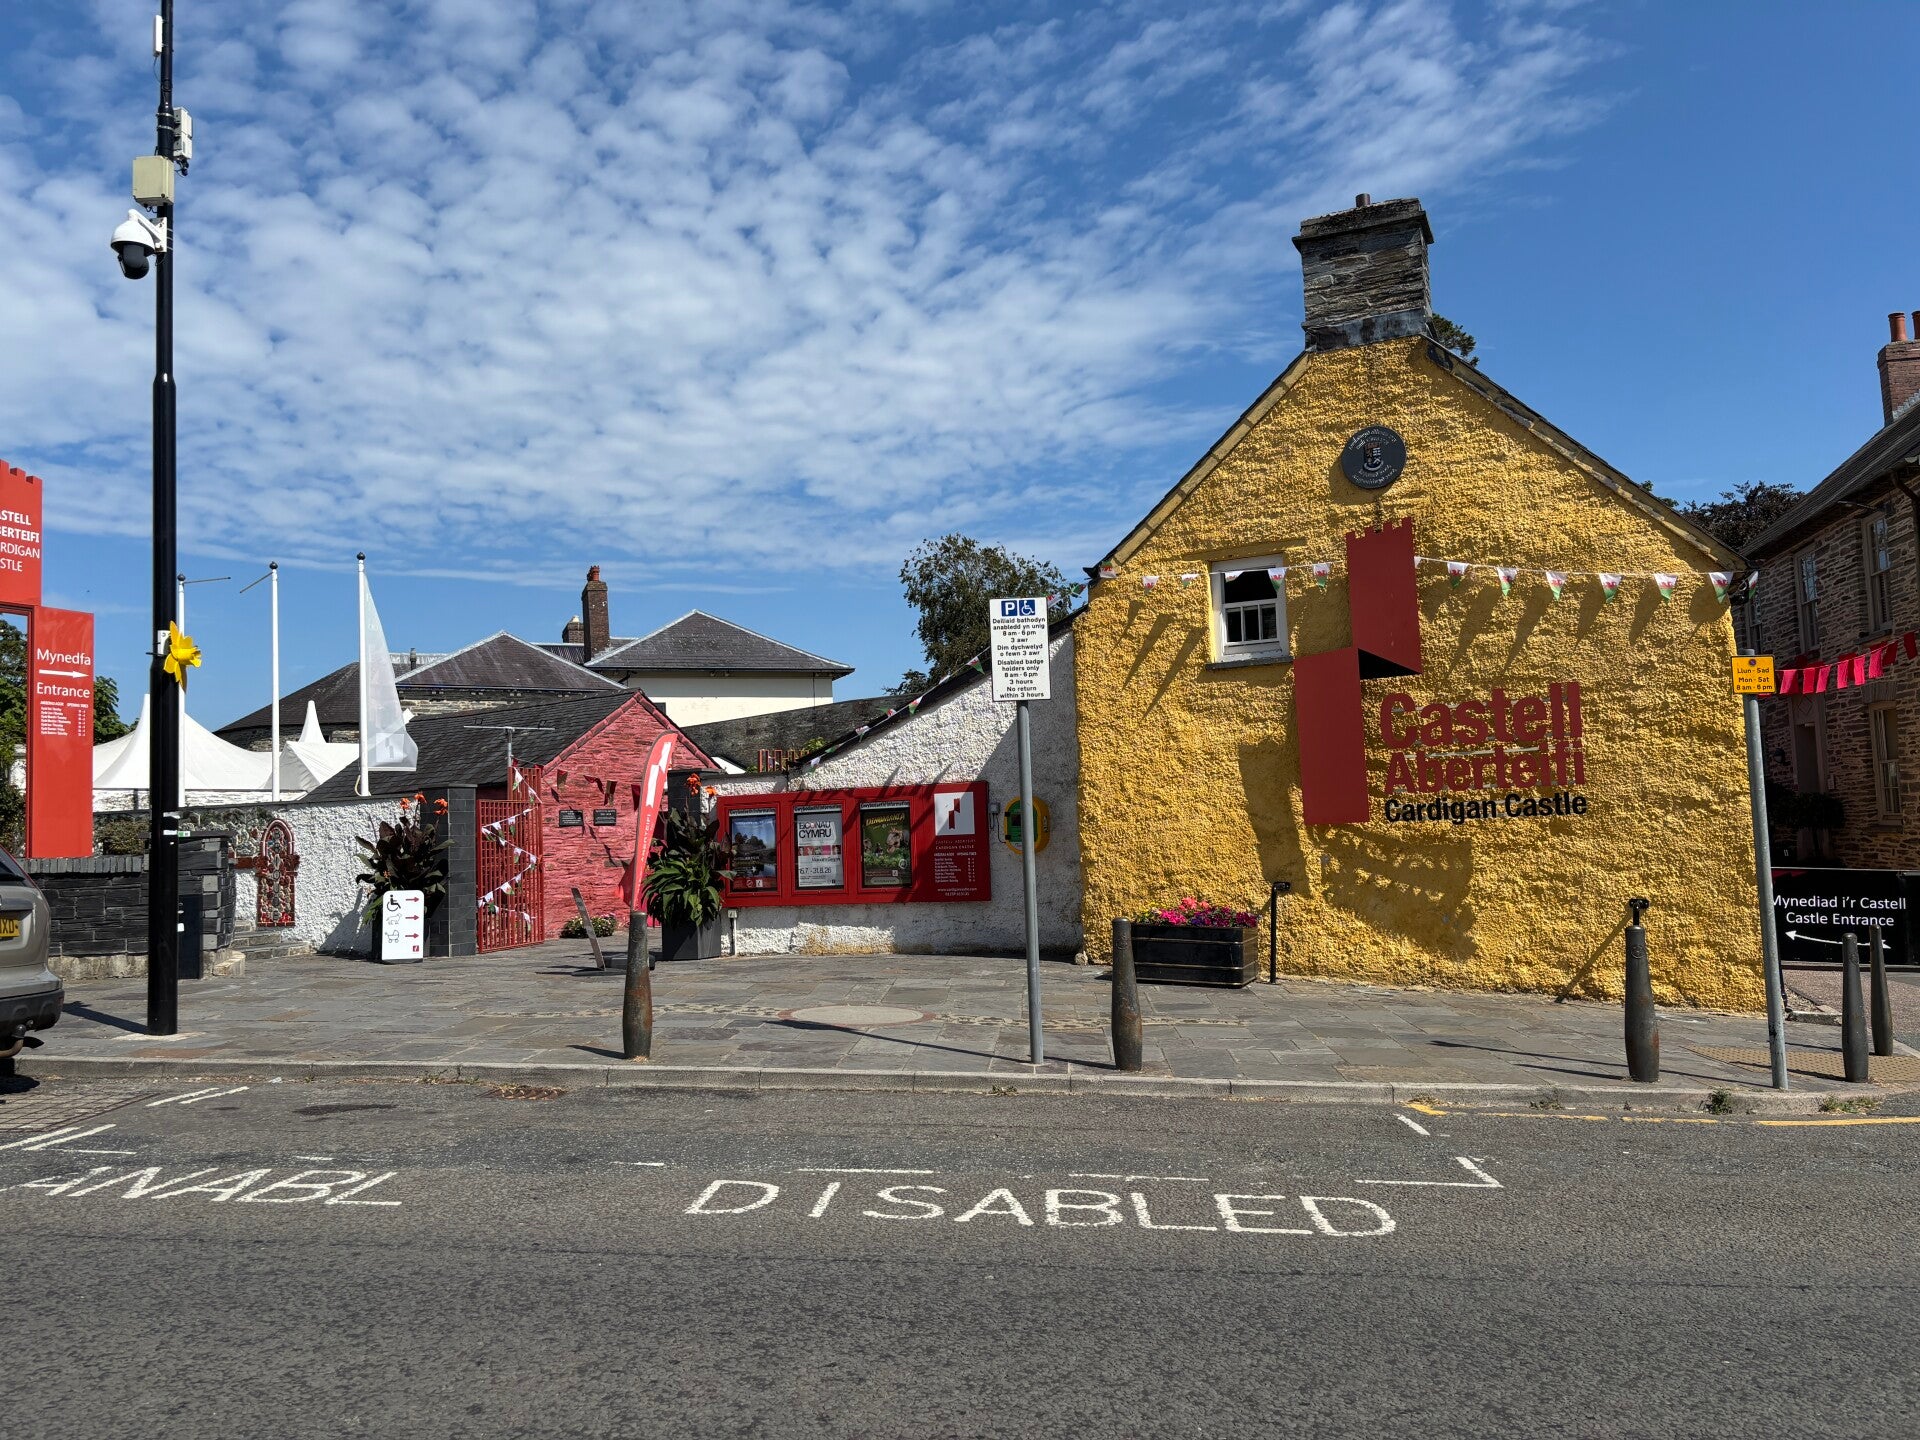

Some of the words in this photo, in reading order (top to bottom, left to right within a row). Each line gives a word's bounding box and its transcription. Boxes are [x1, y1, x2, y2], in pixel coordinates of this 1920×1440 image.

[0, 510, 32, 526] STELL
[0, 526, 40, 542] ERTEIFI
[37, 648, 91, 665] Mynedfa
[37, 682, 90, 698] Entrance
[1380, 682, 1582, 750] Castell
[1384, 743, 1585, 795] Aberteifi
[1384, 798, 1497, 825] Cardigan
[1504, 792, 1588, 818] Castle
[799, 828, 832, 838] CYMRU
[1773, 895, 1838, 909] Mynediad
[1842, 896, 1856, 908] i'r
[1860, 897, 1906, 910] Castell
[0, 919, 14, 934] XD
[1786, 912, 1828, 924] Castle
[1833, 913, 1894, 926] Entrance
[684, 1180, 1396, 1236] DISABLED
